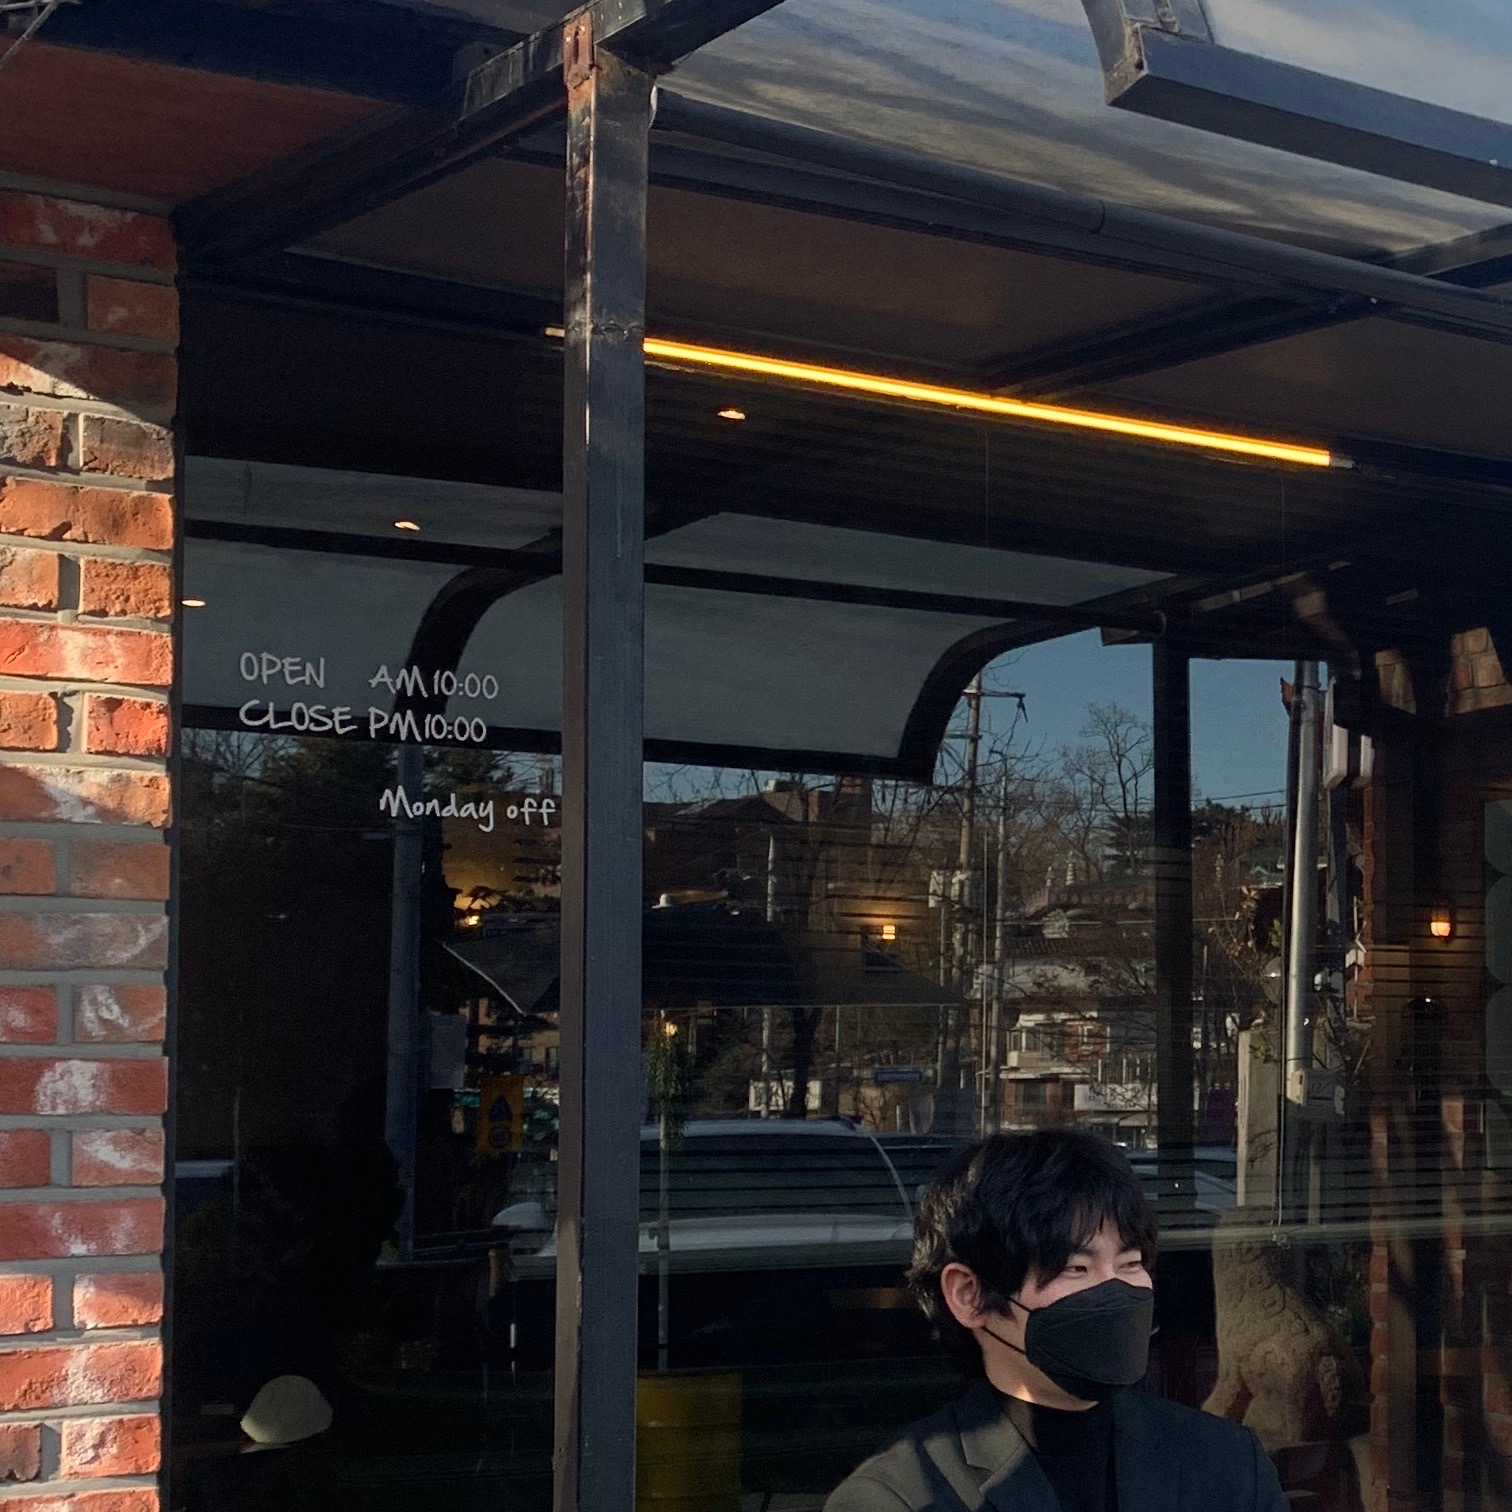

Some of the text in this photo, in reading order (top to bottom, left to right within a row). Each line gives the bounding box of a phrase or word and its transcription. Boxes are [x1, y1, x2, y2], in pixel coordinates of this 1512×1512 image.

[239, 652, 325, 689] OPEN
[239, 700, 358, 735] CLOSE
[379, 785, 557, 833] Monday off
